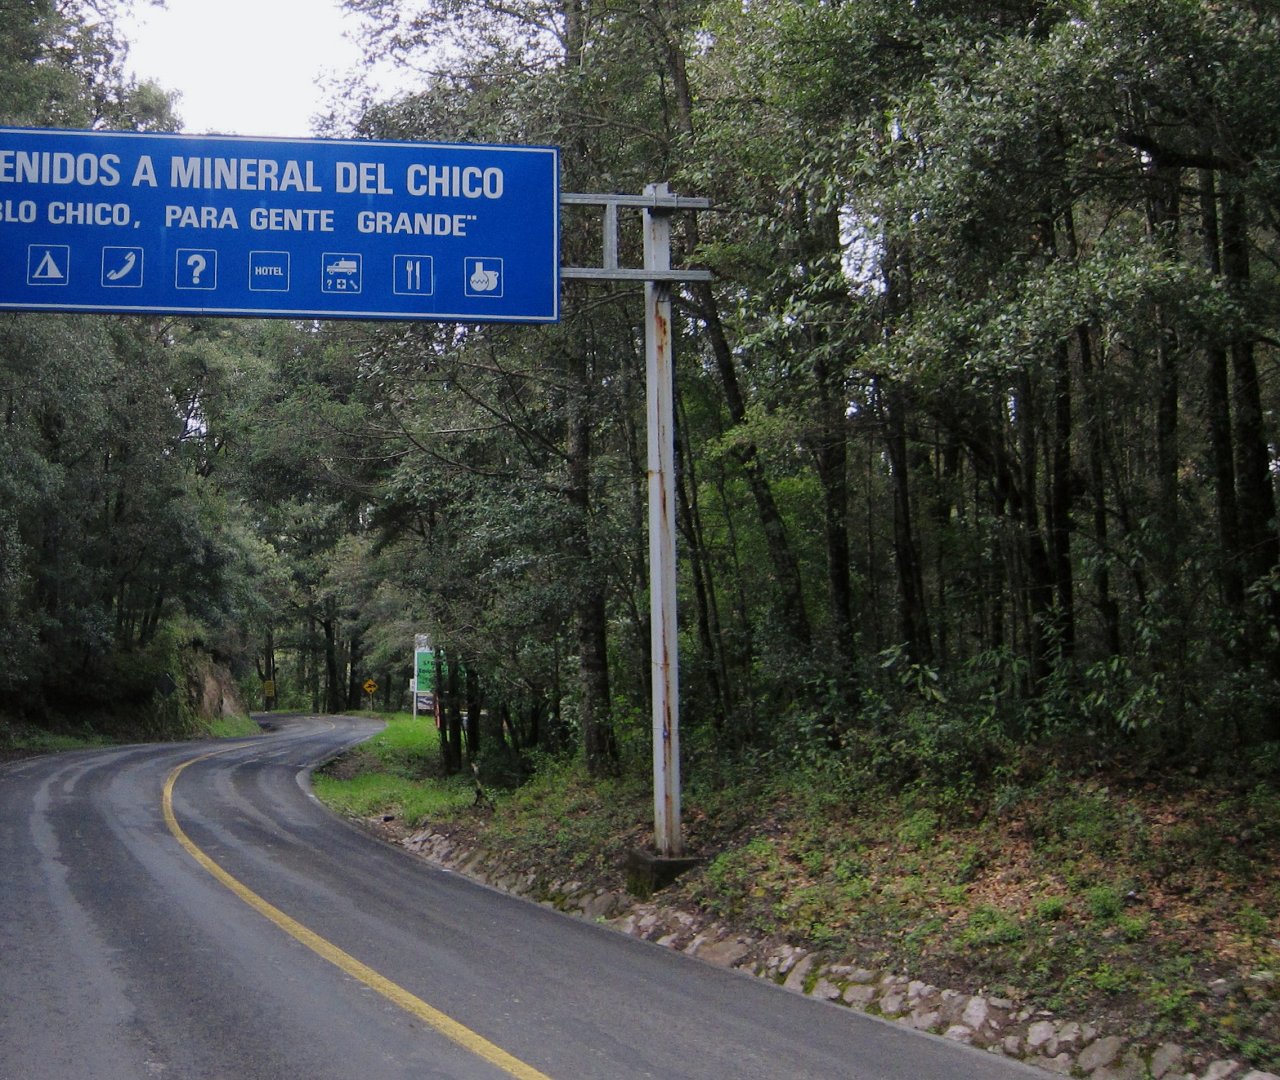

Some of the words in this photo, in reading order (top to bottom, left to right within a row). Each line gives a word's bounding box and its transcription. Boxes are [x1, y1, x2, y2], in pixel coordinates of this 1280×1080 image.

[132, 154, 158, 187] A
[170, 155, 322, 193] MINERAL
[335, 161, 394, 195] DEL
[407, 163, 504, 199] CHICO
[47, 201, 141, 229] CHICO,
[165, 205, 239, 230] PARA
[250, 207, 335, 232] GENTE
[255, 266, 284, 276] HOTEL
